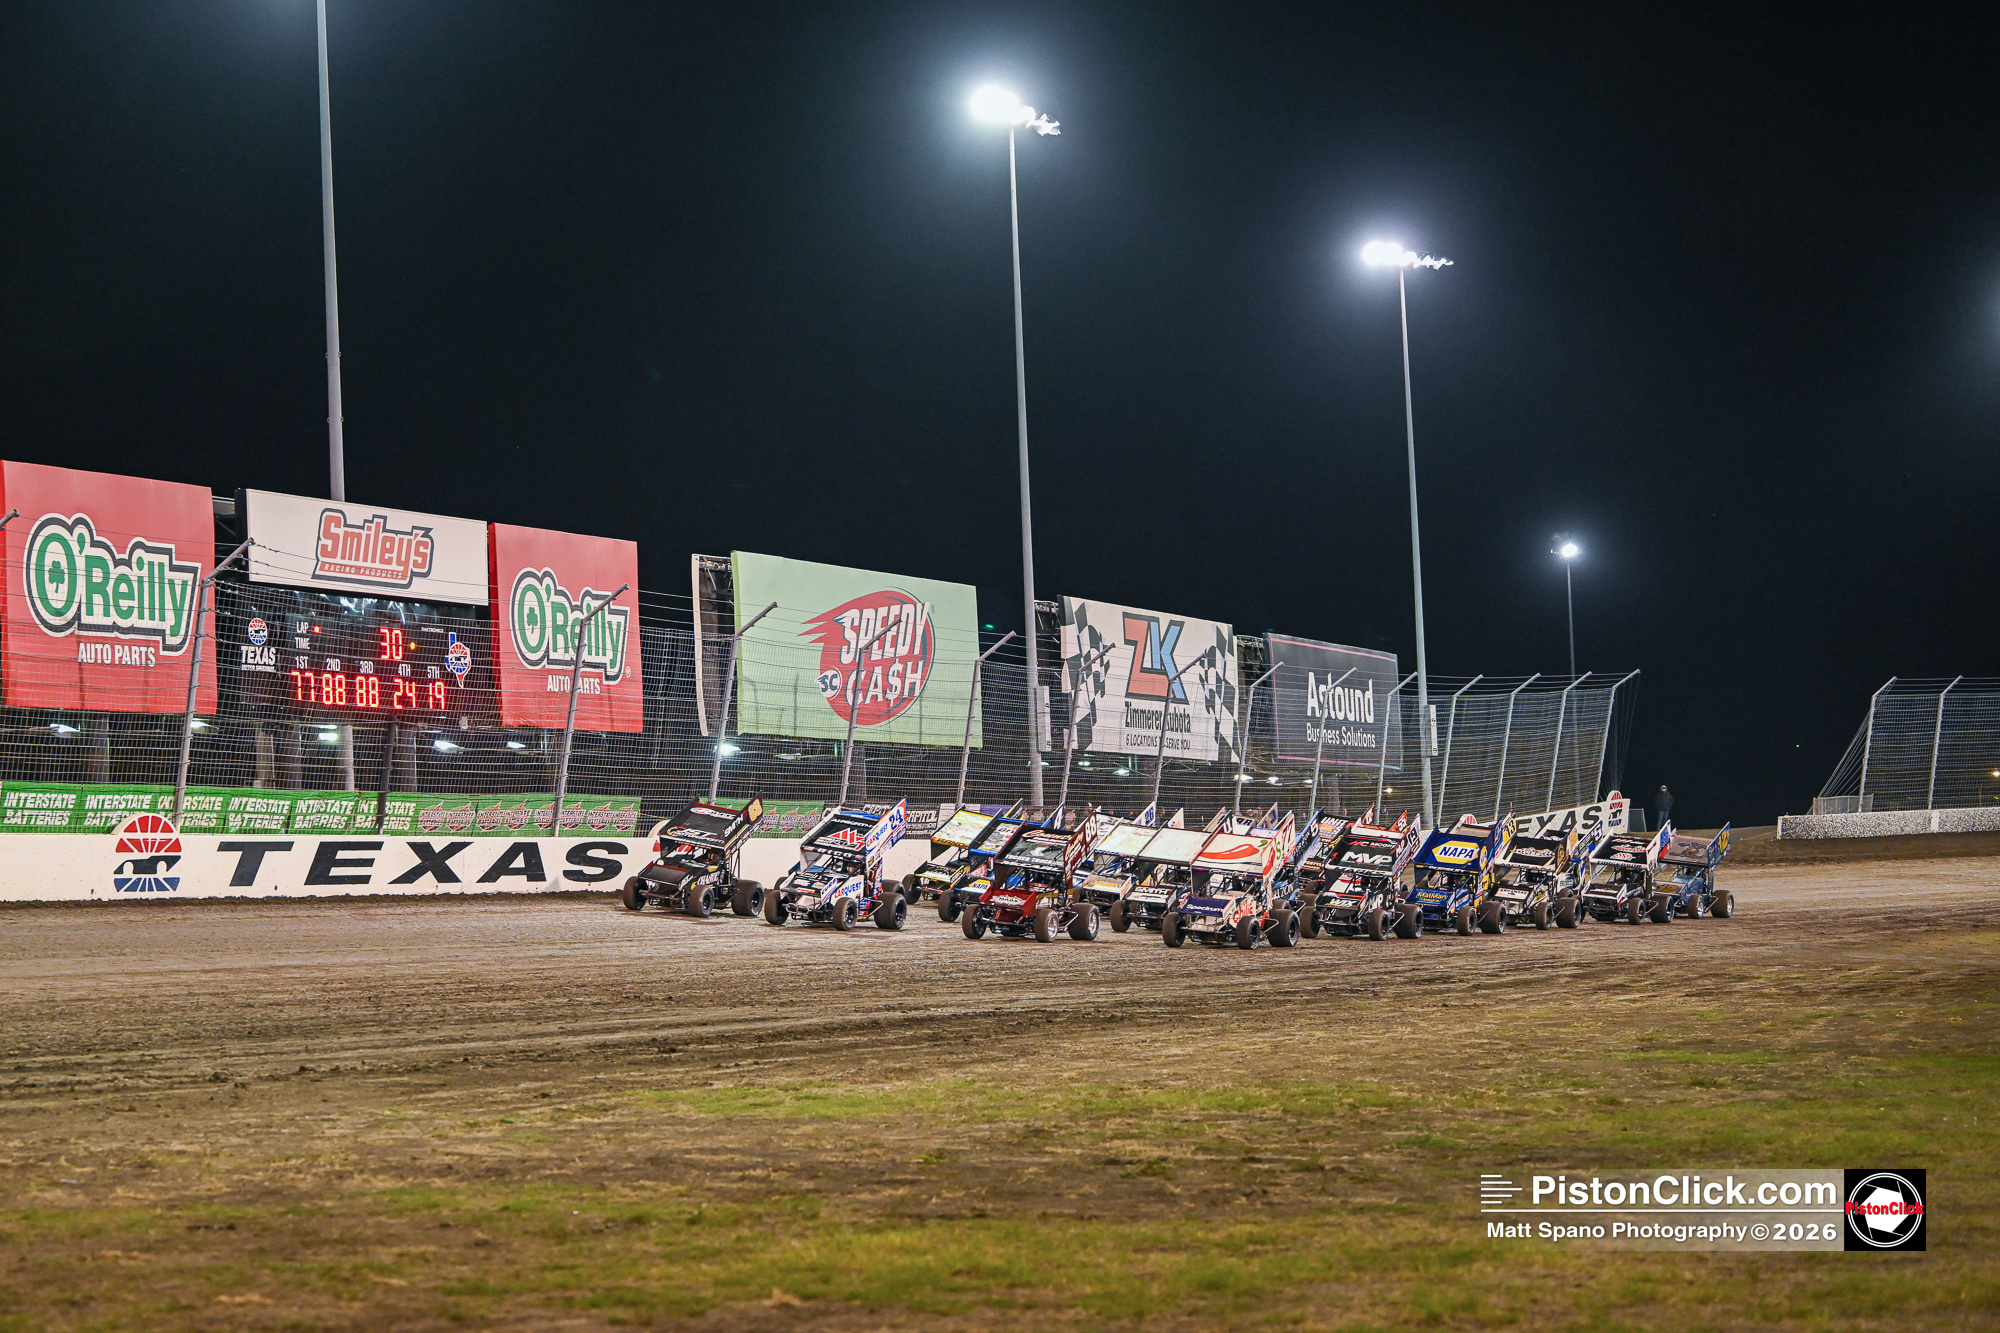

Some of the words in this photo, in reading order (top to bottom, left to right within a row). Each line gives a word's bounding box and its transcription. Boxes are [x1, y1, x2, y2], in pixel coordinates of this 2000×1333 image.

[320, 515, 429, 570] Smiley's
[324, 563, 355, 573] RACING
[360, 566, 403, 579] PRODUCTS
[34, 531, 189, 637] O'Reilly
[296, 621, 309, 634] LAP
[517, 583, 622, 669] O'Reilly
[832, 601, 930, 665] SPEEDY
[294, 636, 310, 650] TIME
[380, 628, 403, 660] 30
[77, 641, 112, 665] AUTO
[114, 644, 156, 668] PARTS
[241, 645, 276, 666] TEXAS
[1122, 611, 1190, 705] ZK
[294, 655, 309, 670] 1ST
[326, 658, 341, 672] 2ND
[359, 660, 374, 675] 3RD
[397, 663, 411, 678] 4TH
[427, 666, 440, 680] 5TH
[291, 671, 315, 701] 77
[322, 673, 346, 706] 88
[356, 676, 379, 708] 88
[393, 678, 416, 710] 24
[428, 681, 445, 711] 19
[547, 674, 570, 694] AUTO
[573, 677, 601, 695] ARTS
[1306, 671, 1374, 724] Astound
[1125, 700, 1163, 731] Zimmerer
[1125, 734, 1130, 746] 6
[1130, 734, 1158, 748] LOCATIONS
[1165, 737, 1179, 750] SERVE
[1180, 738, 1191, 751] YOU
[1306, 722, 1340, 745] Busness
[1341, 725, 1376, 748] Solutions
[3, 792, 77, 809] INTERSTATE
[85, 794, 152, 810] INTERSTATE
[158, 795, 223, 811] INTRSTATE
[228, 797, 291, 814] INTERSTATE
[357, 799, 416, 816] INTRSTATE
[3, 809, 71, 826] BATTERIES
[228, 813, 286, 829] BATTERIES
[888, 808, 904, 830] 24
[1144, 806, 1154, 825] 26
[1516, 805, 1602, 837] EXAS
[866, 823, 888, 847] CARQUEST
[1085, 815, 1097, 842] 88
[1309, 818, 1319, 838] 5
[1341, 851, 1393, 866] MVP
[1439, 846, 1475, 859] NAPA
[217, 841, 629, 887] TEXAS
[834, 881, 862, 899] CARQUEST
[972, 882, 989, 890] NAPA
[1186, 903, 1224, 913] Spectrum
[1330, 898, 1358, 907] WIX
